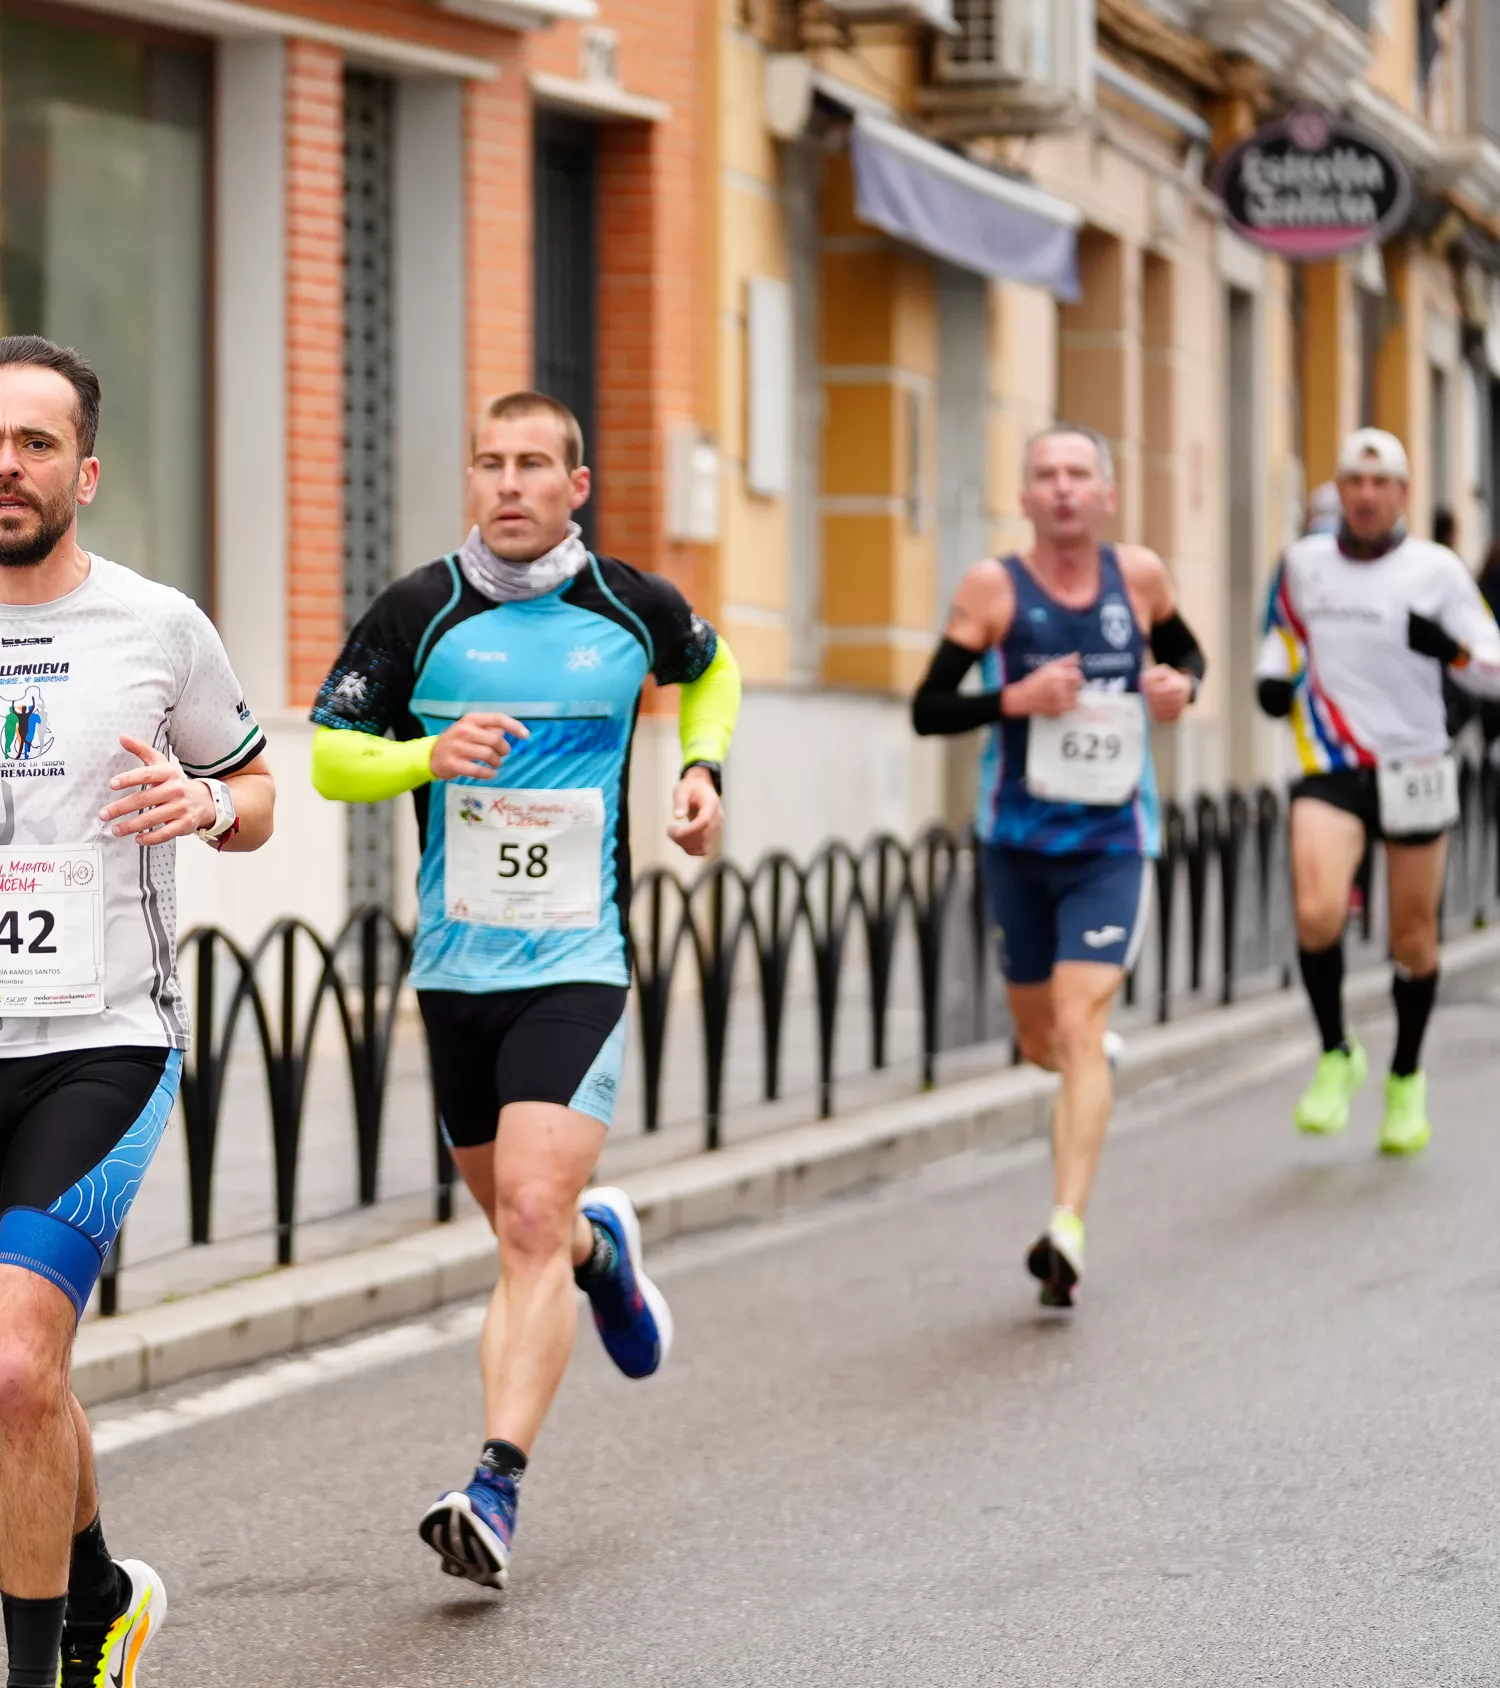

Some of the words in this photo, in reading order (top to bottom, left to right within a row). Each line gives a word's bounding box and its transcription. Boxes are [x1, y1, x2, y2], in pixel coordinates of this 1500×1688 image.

[1061, 732, 1122, 764] 629
[498, 843, 548, 878] 58
[9, 968, 33, 976] RAMOS
